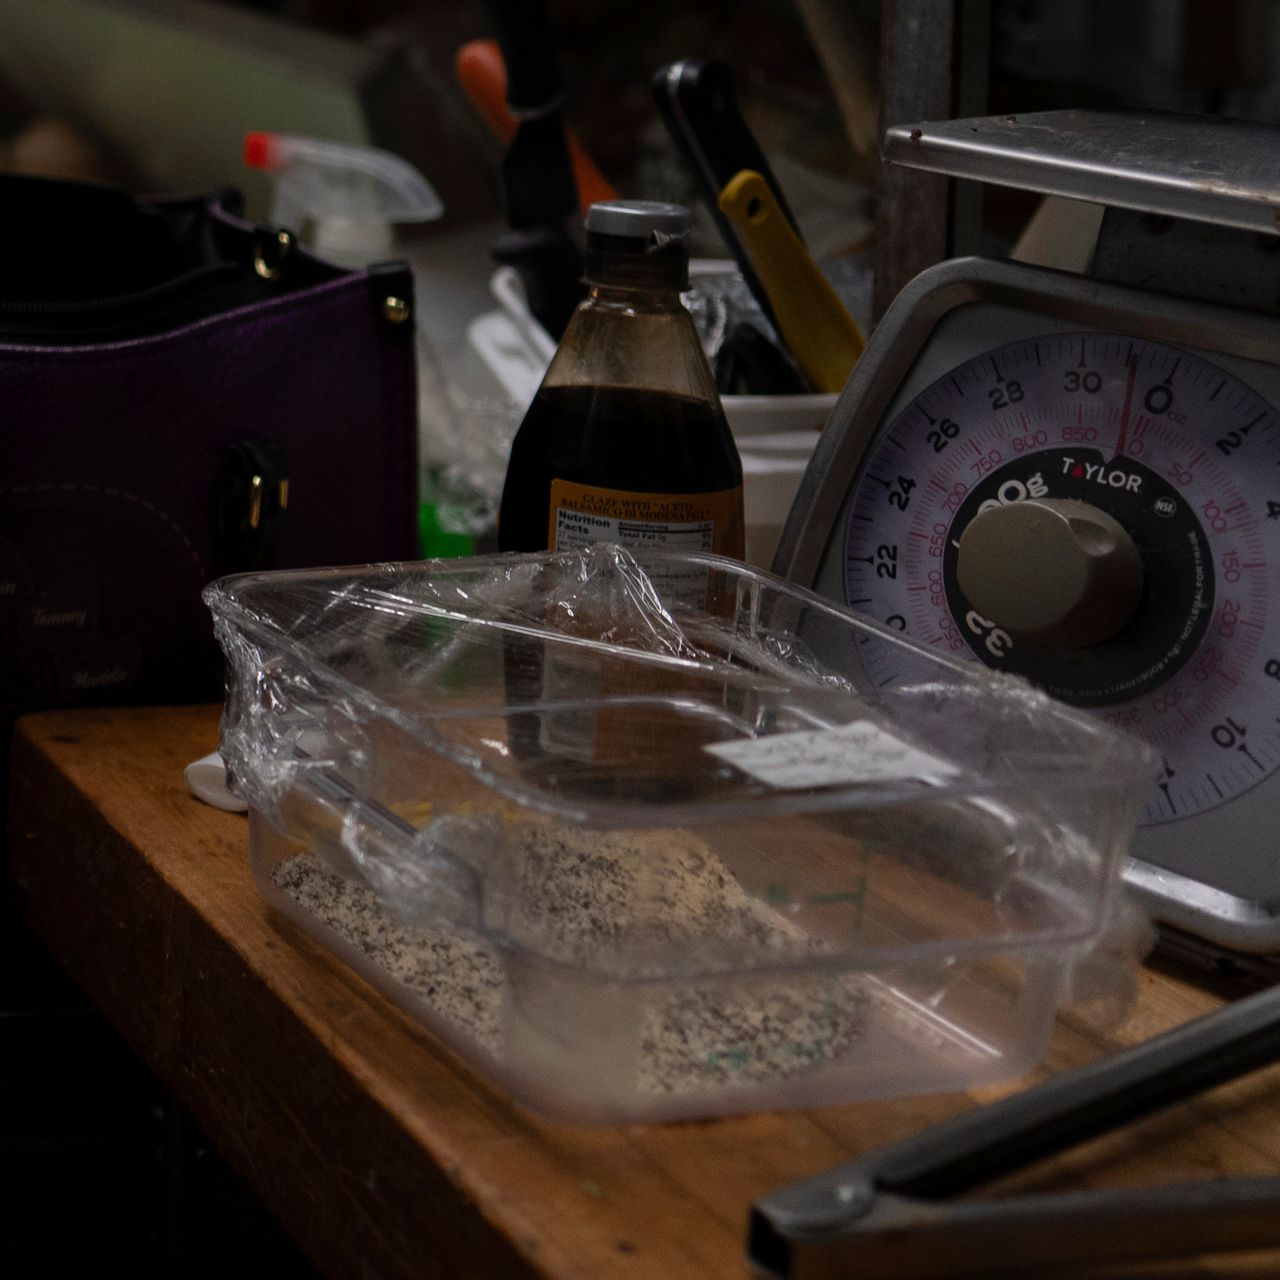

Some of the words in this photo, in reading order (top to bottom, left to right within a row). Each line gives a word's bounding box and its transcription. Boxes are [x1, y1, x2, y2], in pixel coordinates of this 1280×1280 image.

[989, 380, 1025, 411] 28
[1063, 371, 1102, 393] 30
[1144, 385, 1174, 414] 0
[926, 419, 960, 453] 26
[1012, 430, 1048, 452] 800
[1062, 426, 1098, 441] 850
[1128, 439, 1144, 454] 0
[1216, 432, 1242, 456] 2
[970, 450, 1002, 478] 750
[1061, 457, 1143, 493] TAYLOR
[1170, 462, 1192, 485] 50
[583, 495, 616, 506] GLAZE
[622, 499, 650, 511] WITH
[888, 476, 916, 511] 24
[941, 482, 968, 514] 700
[1154, 499, 1174, 513] NSF
[558, 510, 611, 528] Nutrition
[561, 497, 622, 517] BALSAMICO
[640, 510, 684, 520] MODENA
[1203, 499, 1227, 532] 100
[1267, 501, 1280, 519] 4
[558, 520, 589, 534] Facts
[618, 531, 640, 539] Total
[642, 532, 656, 540] Fat
[929, 523, 948, 558] 650
[876, 545, 897, 579] 22
[1222, 550, 1241, 583] 150
[928, 570, 944, 606] 600
[1195, 566, 1204, 588] FOR
[1218, 599, 1241, 638] 200
[938, 619, 964, 652] 550
[1211, 717, 1247, 748] 10
